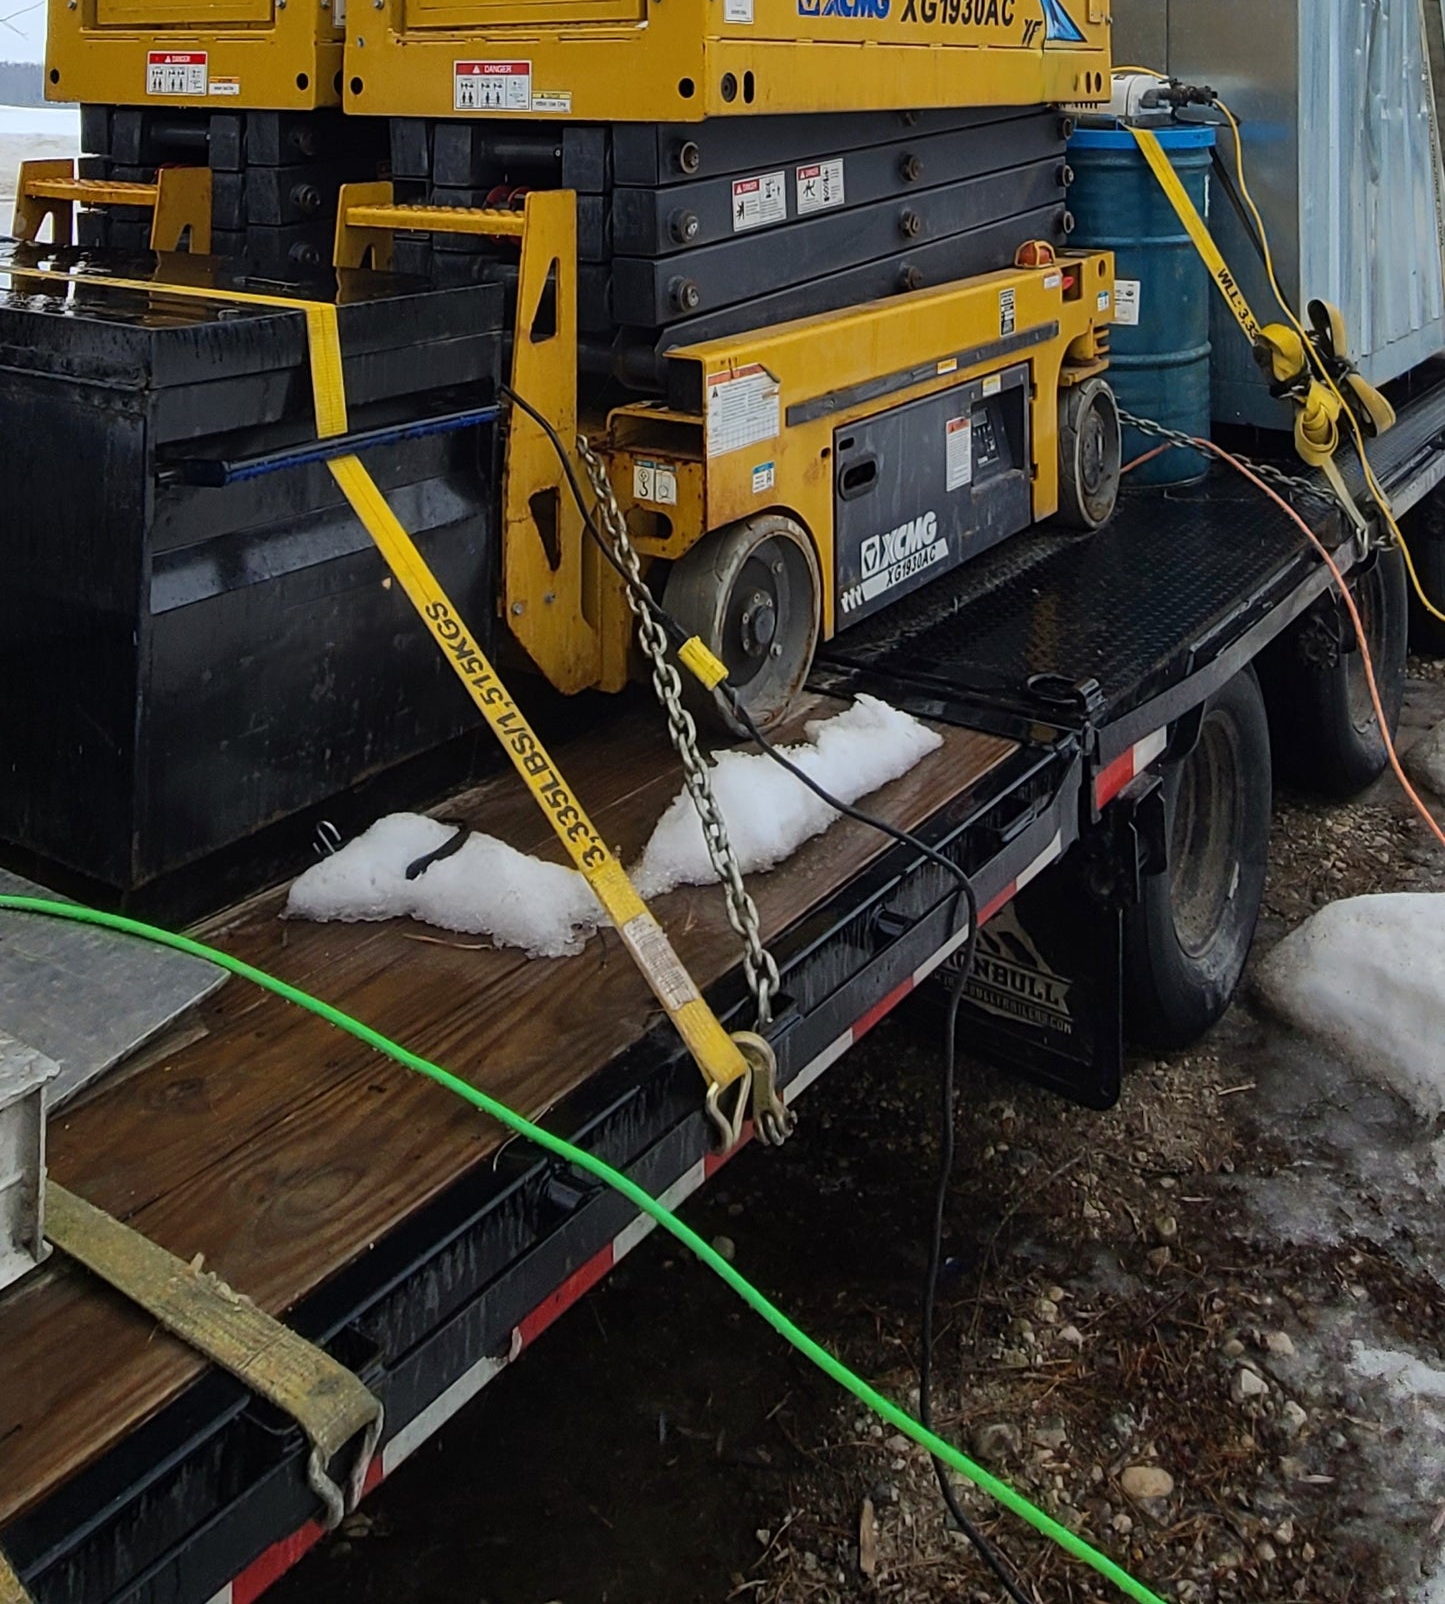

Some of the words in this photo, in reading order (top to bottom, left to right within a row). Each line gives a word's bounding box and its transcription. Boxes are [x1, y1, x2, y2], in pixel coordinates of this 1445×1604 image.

[484, 65, 512, 73] DANGER
[880, 511, 937, 570] XCMG
[886, 545, 936, 588] XG1930AC
[425, 600, 605, 868] 3,335LBS/1,515KGS
